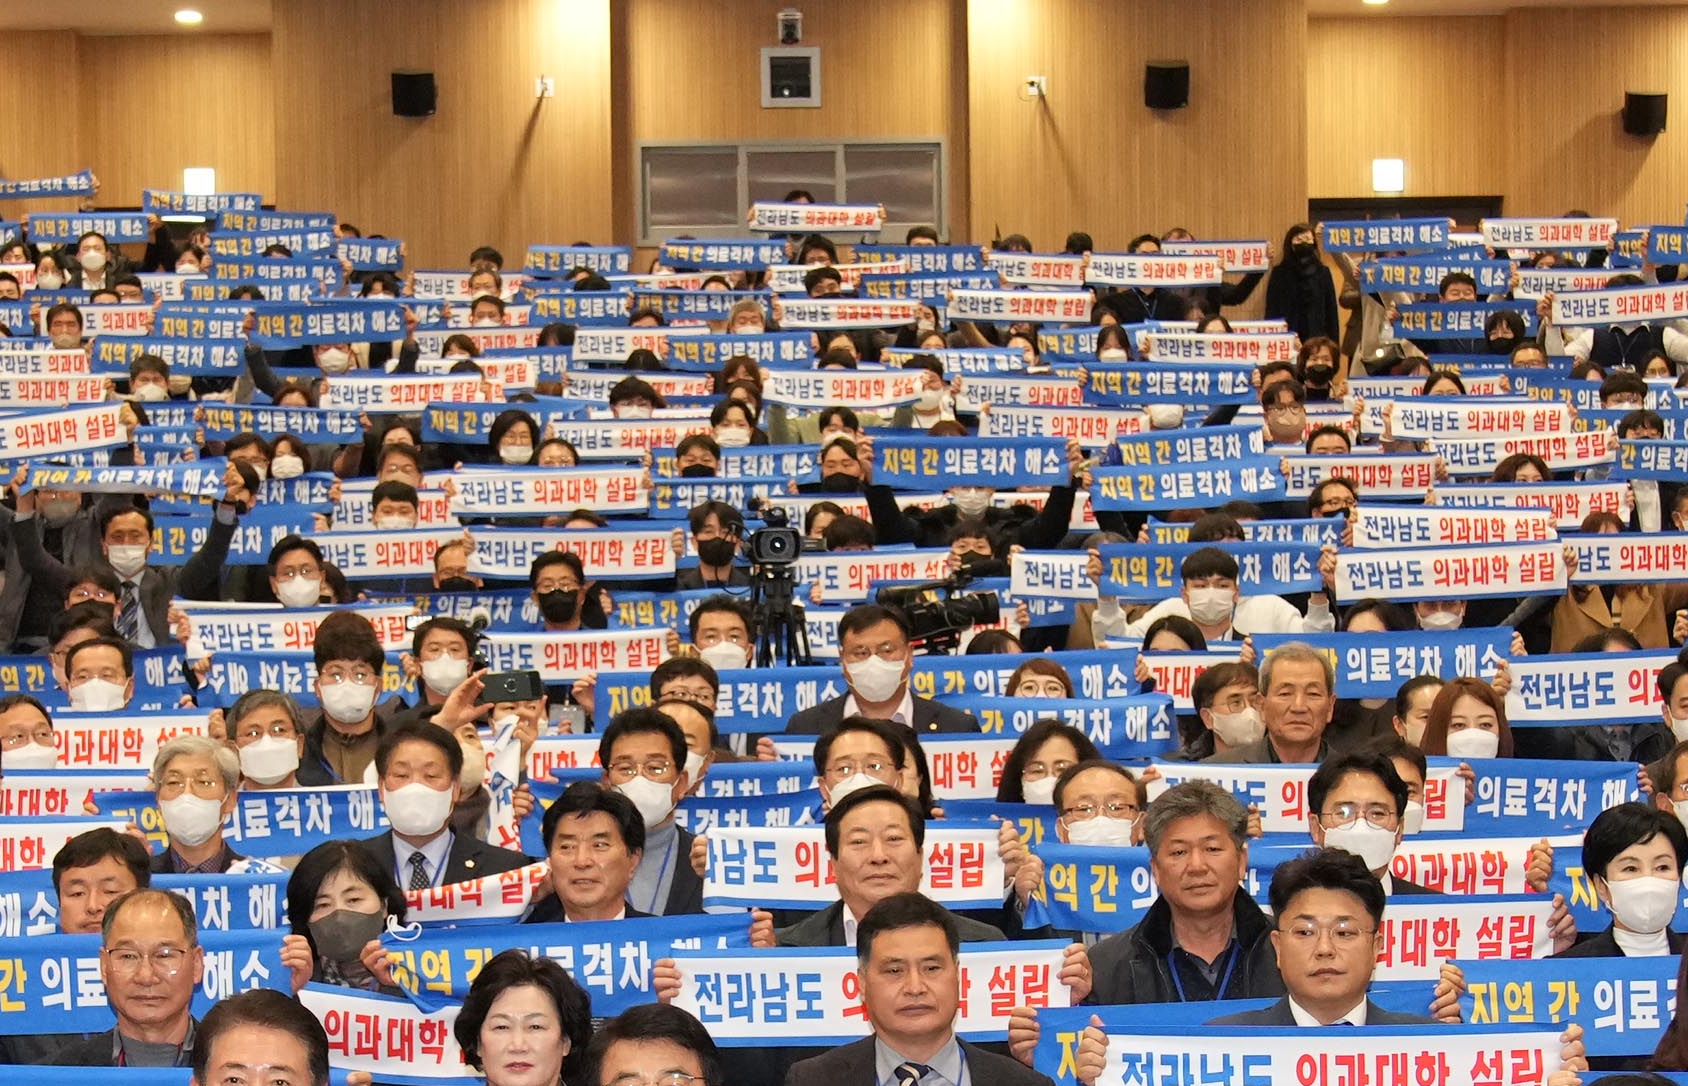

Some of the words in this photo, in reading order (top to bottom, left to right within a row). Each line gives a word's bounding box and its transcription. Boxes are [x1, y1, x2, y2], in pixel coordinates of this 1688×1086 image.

[1329, 230, 1351, 245] 지역
[1355, 230, 1365, 246] 간
[1368, 228, 1414, 245] 의료격차
[1420, 227, 1442, 243] 해소
[673, 342, 698, 362] 지역
[703, 342, 716, 361] 간
[720, 341, 774, 361] 의료격차
[781, 340, 807, 359] 해소
[17, 381, 69, 401] 의과대학
[76, 376, 101, 400] 설립
[1091, 372, 1121, 394] 지역
[1128, 372, 1140, 394] 간
[1147, 371, 1207, 394] 의료격차
[1218, 369, 1248, 393] 해소
[882, 448, 916, 475] 지역
[922, 449, 938, 475] 간
[945, 448, 1015, 475] 의료격차
[1026, 447, 1059, 474] 해소
[1100, 476, 1132, 500] 지역
[1138, 475, 1154, 501] 간
[1161, 471, 1231, 498] 의료격차
[1241, 467, 1275, 492] 해소
[1347, 559, 1423, 591] 전라남도
[1434, 557, 1508, 586] 의과대학
[1520, 553, 1555, 582] 설립
[198, 625, 274, 650] 전라남도
[543, 636, 614, 671] 의과대학
[627, 635, 661, 665] 설립
[26, 666, 45, 691] 간
[1082, 664, 1127, 698] 해소
[1476, 774, 1587, 820] 의료격차
[1091, 863, 1117, 911] 간
[1476, 915, 1534, 959] 설립
[695, 973, 823, 1021] 전라남도
[329, 1009, 445, 1064] 의과대학
